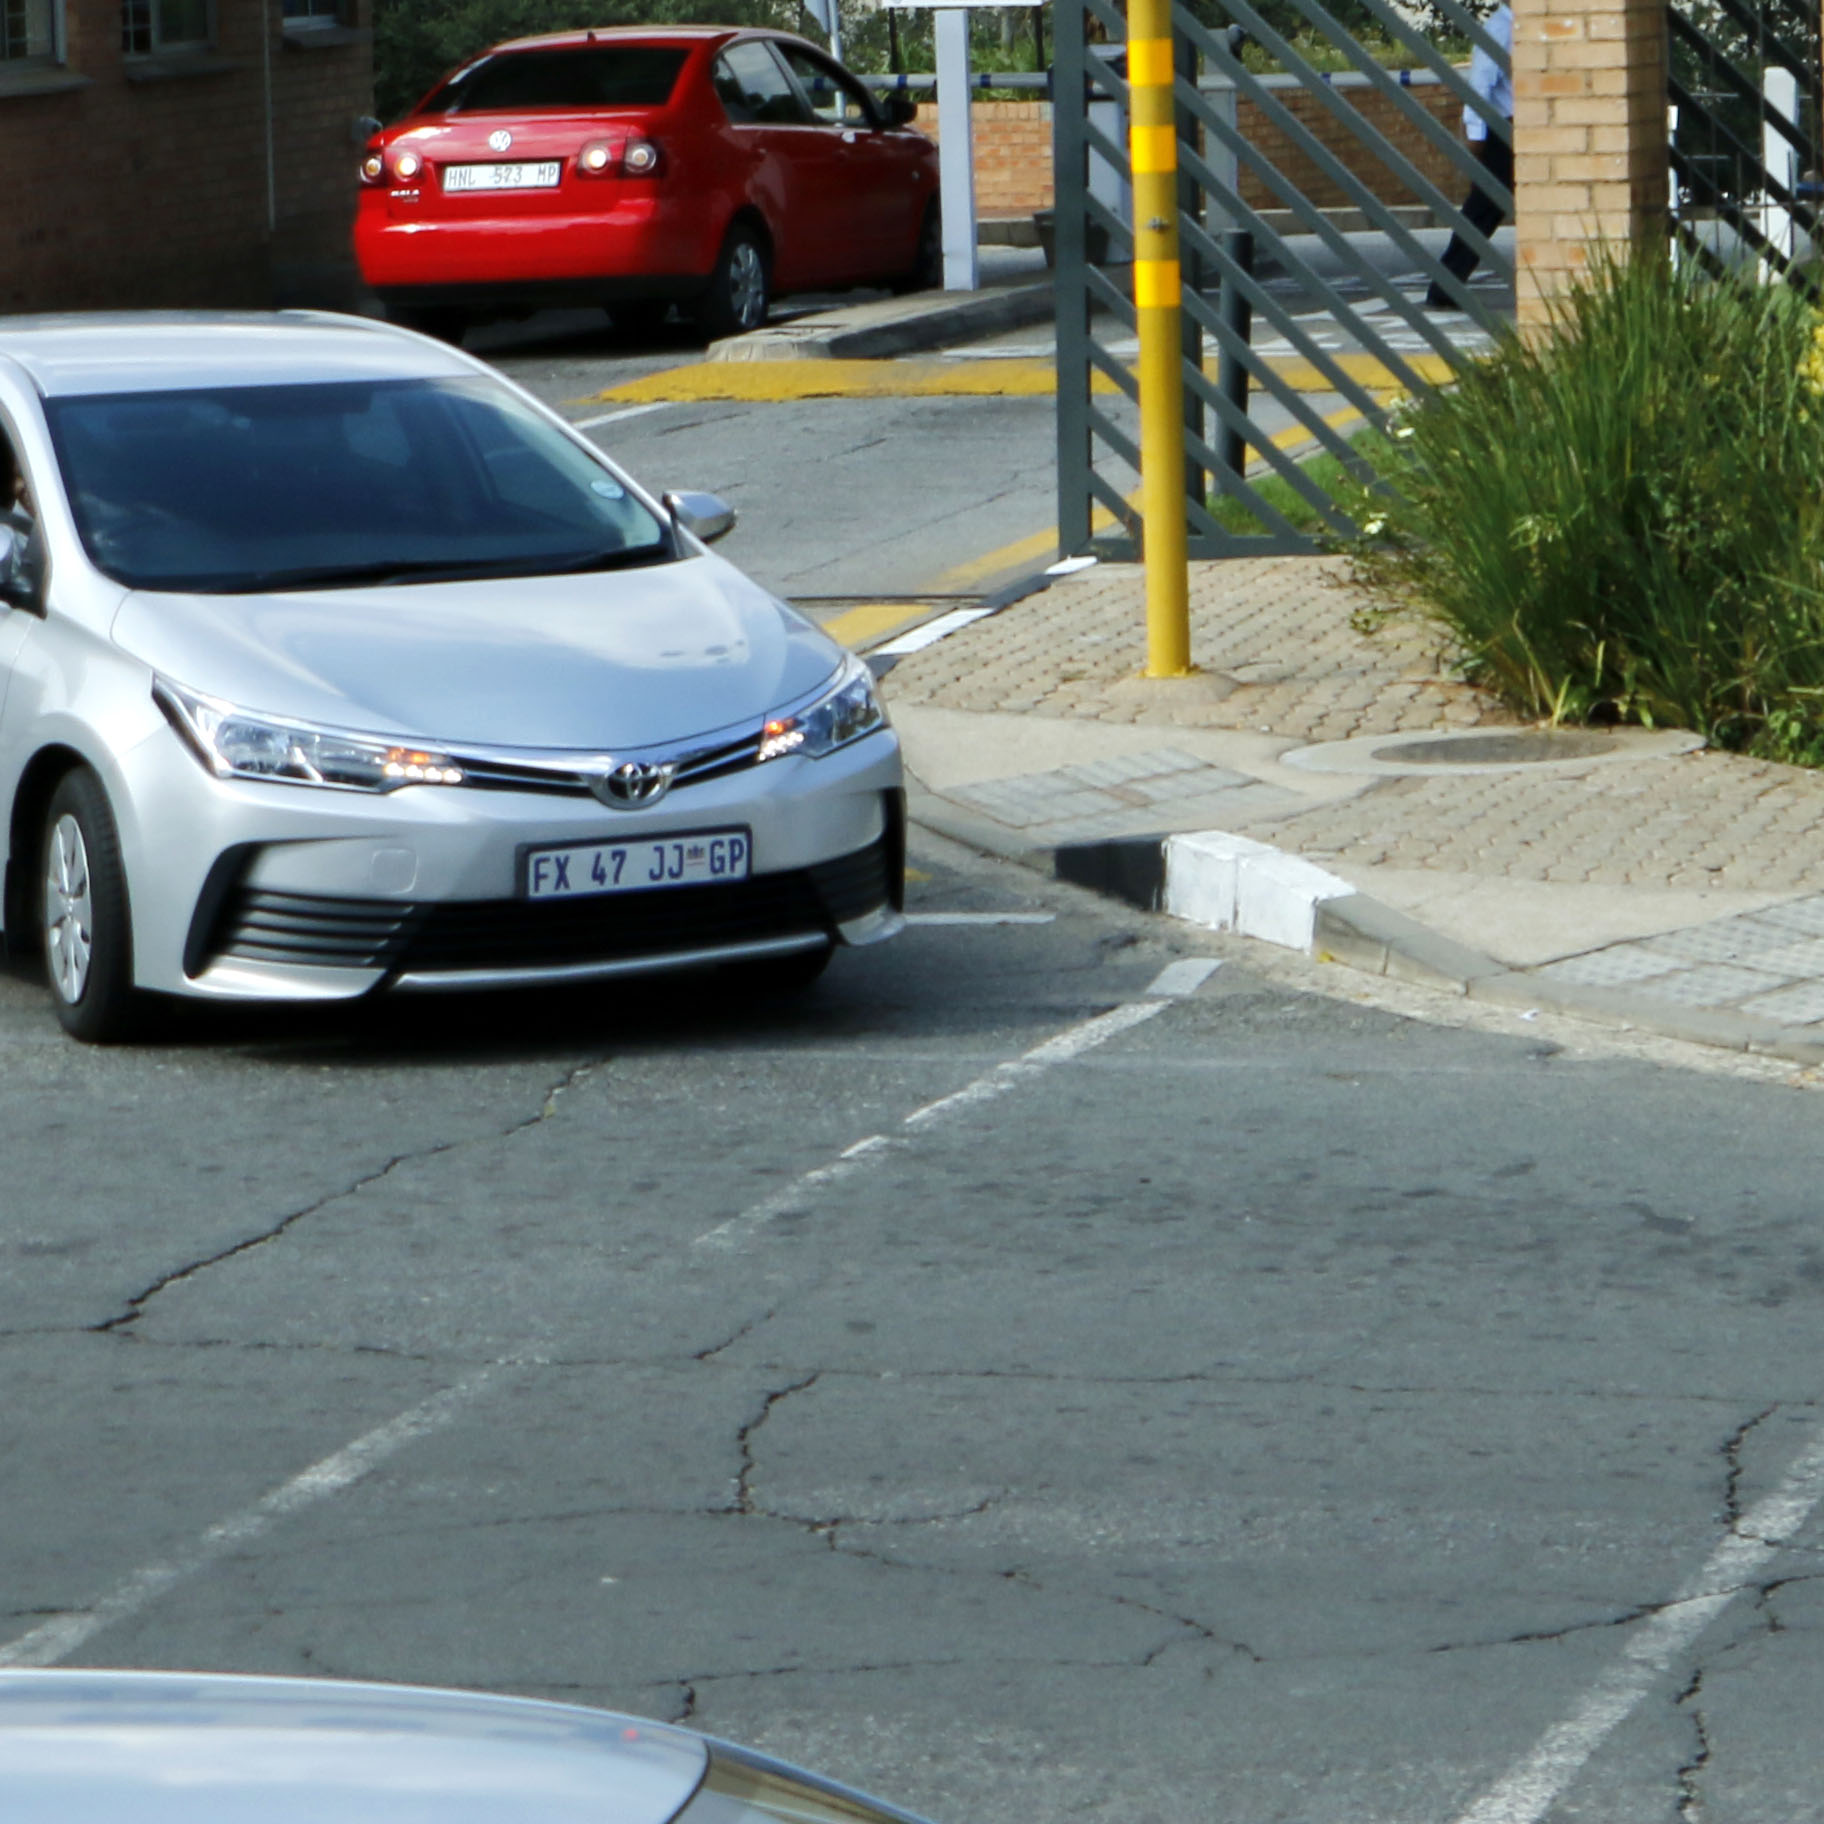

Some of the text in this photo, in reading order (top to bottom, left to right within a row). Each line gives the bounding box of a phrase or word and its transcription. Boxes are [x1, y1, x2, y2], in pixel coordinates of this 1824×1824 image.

[532, 837, 746, 894] FX 47 JJ GP
